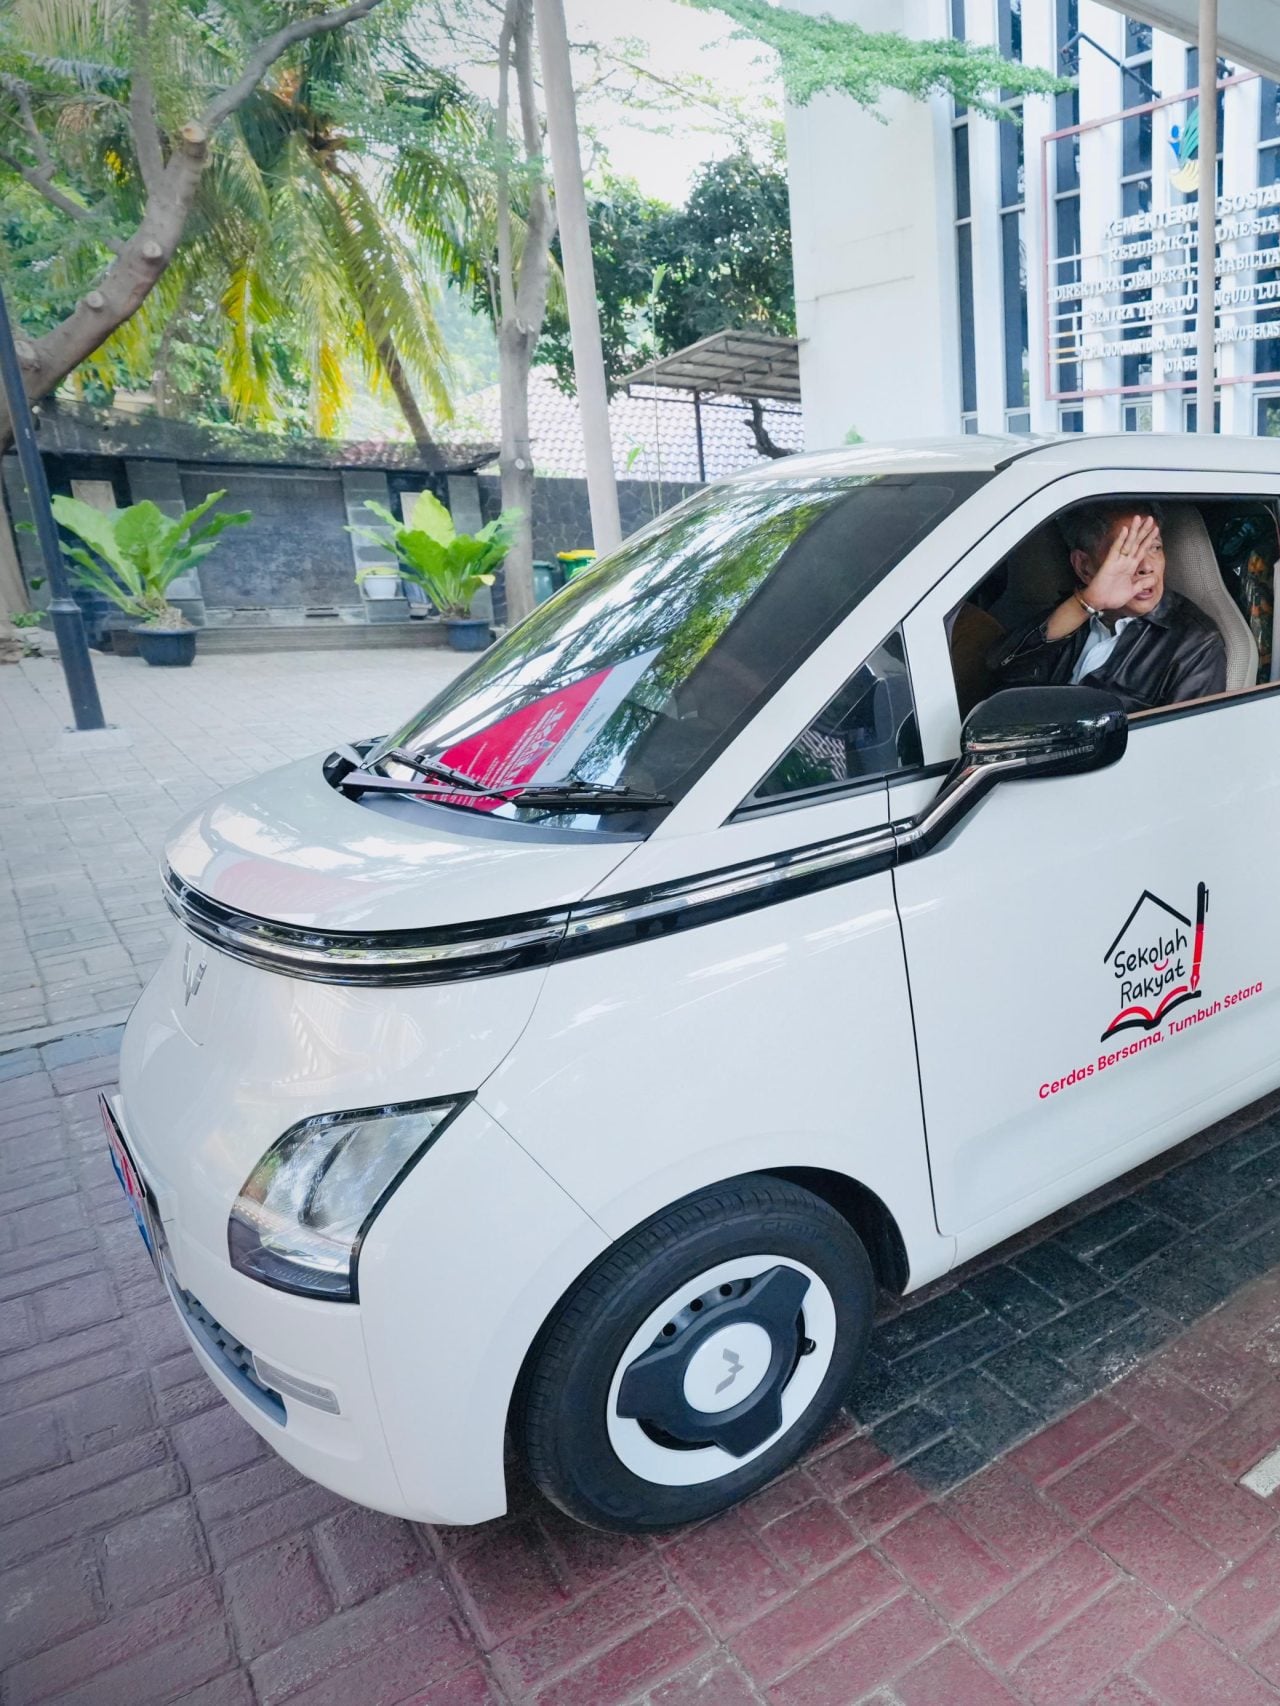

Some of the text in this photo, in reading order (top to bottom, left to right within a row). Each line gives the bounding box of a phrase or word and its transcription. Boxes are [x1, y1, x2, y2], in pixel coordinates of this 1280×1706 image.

[1105, 202, 1200, 239] KEMENTERIA
[1110, 214, 1280, 262] REPUBLIK IONESIA
[1128, 267, 1196, 289] JENDERAL
[1089, 303, 1136, 324] SENTRA
[1137, 297, 1195, 319] TERPADU
[1214, 286, 1256, 307] NGUDI
[1113, 928, 1188, 978] Sekolah
[1120, 957, 1186, 1009] Rakyat
[1038, 980, 1263, 1099] Cerdas Bersama, Tumbuh Setara
